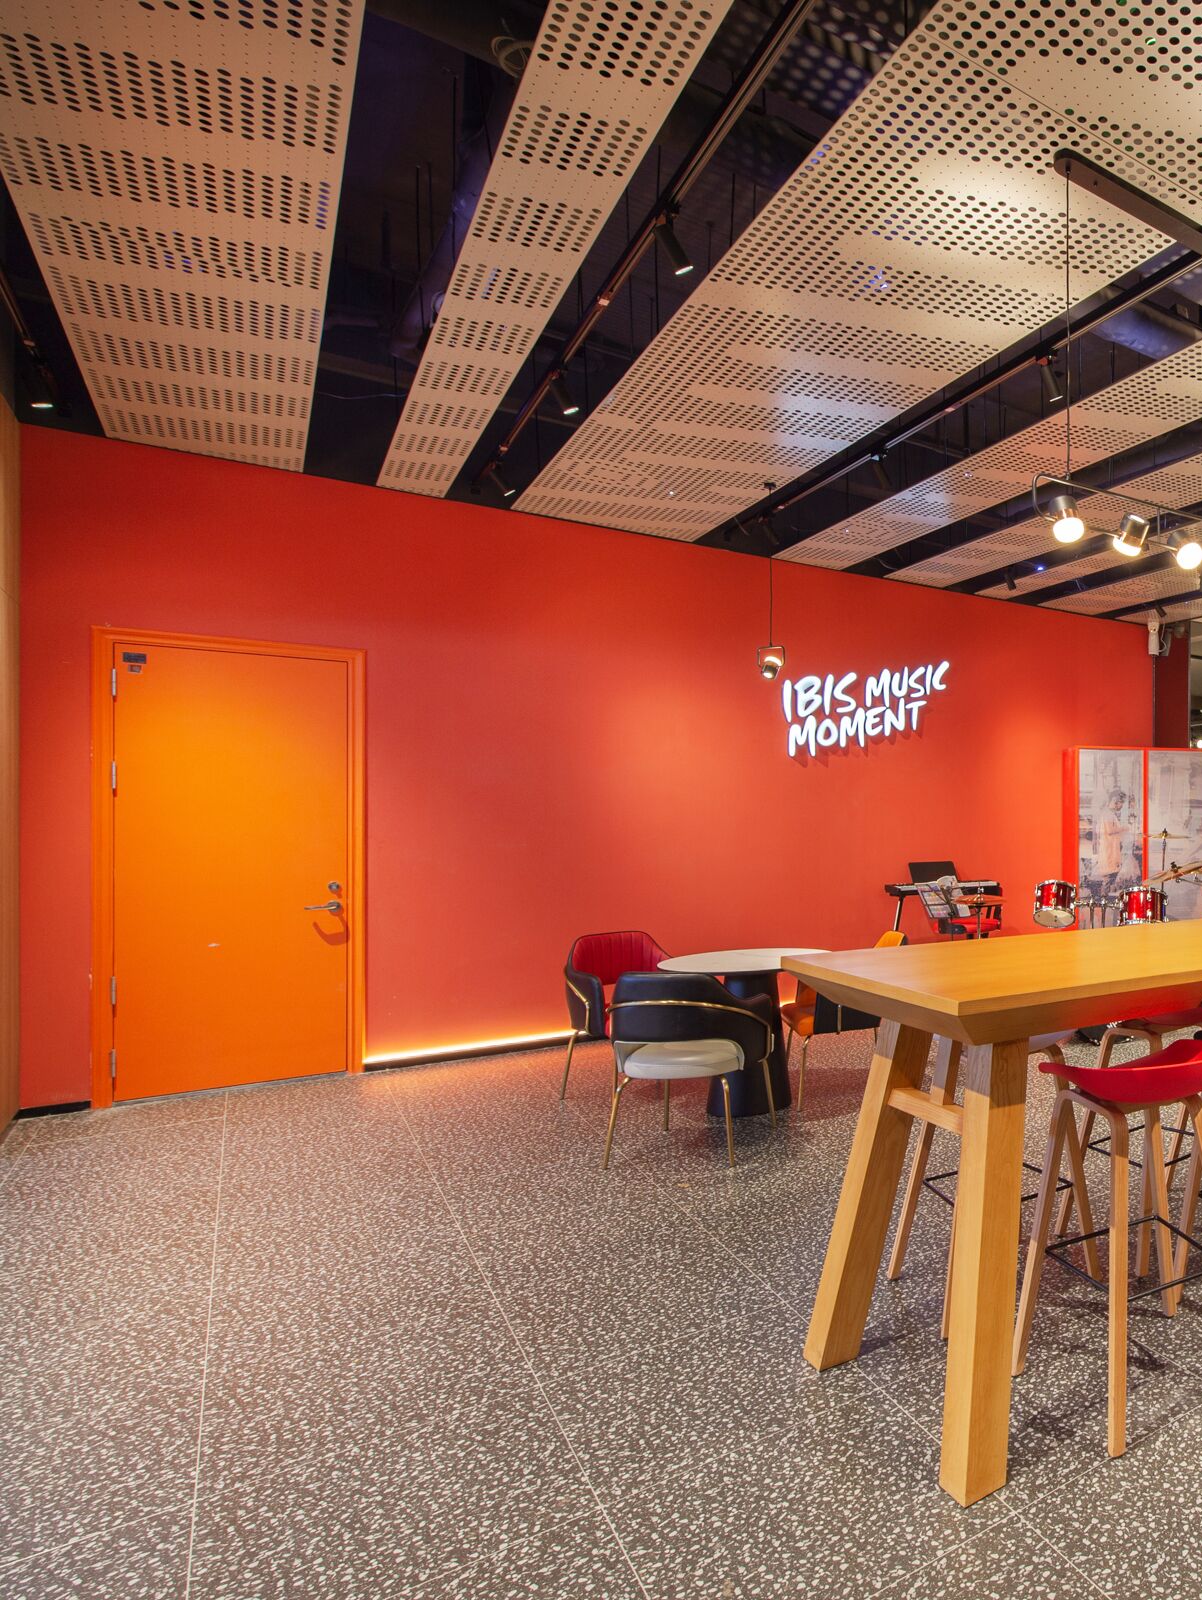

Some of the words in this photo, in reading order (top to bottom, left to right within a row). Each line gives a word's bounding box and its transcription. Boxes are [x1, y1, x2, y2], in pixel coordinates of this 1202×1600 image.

[782, 671, 858, 723] IBIS
[865, 660, 950, 708] MUSIC
[788, 697, 928, 757] MOMENT
